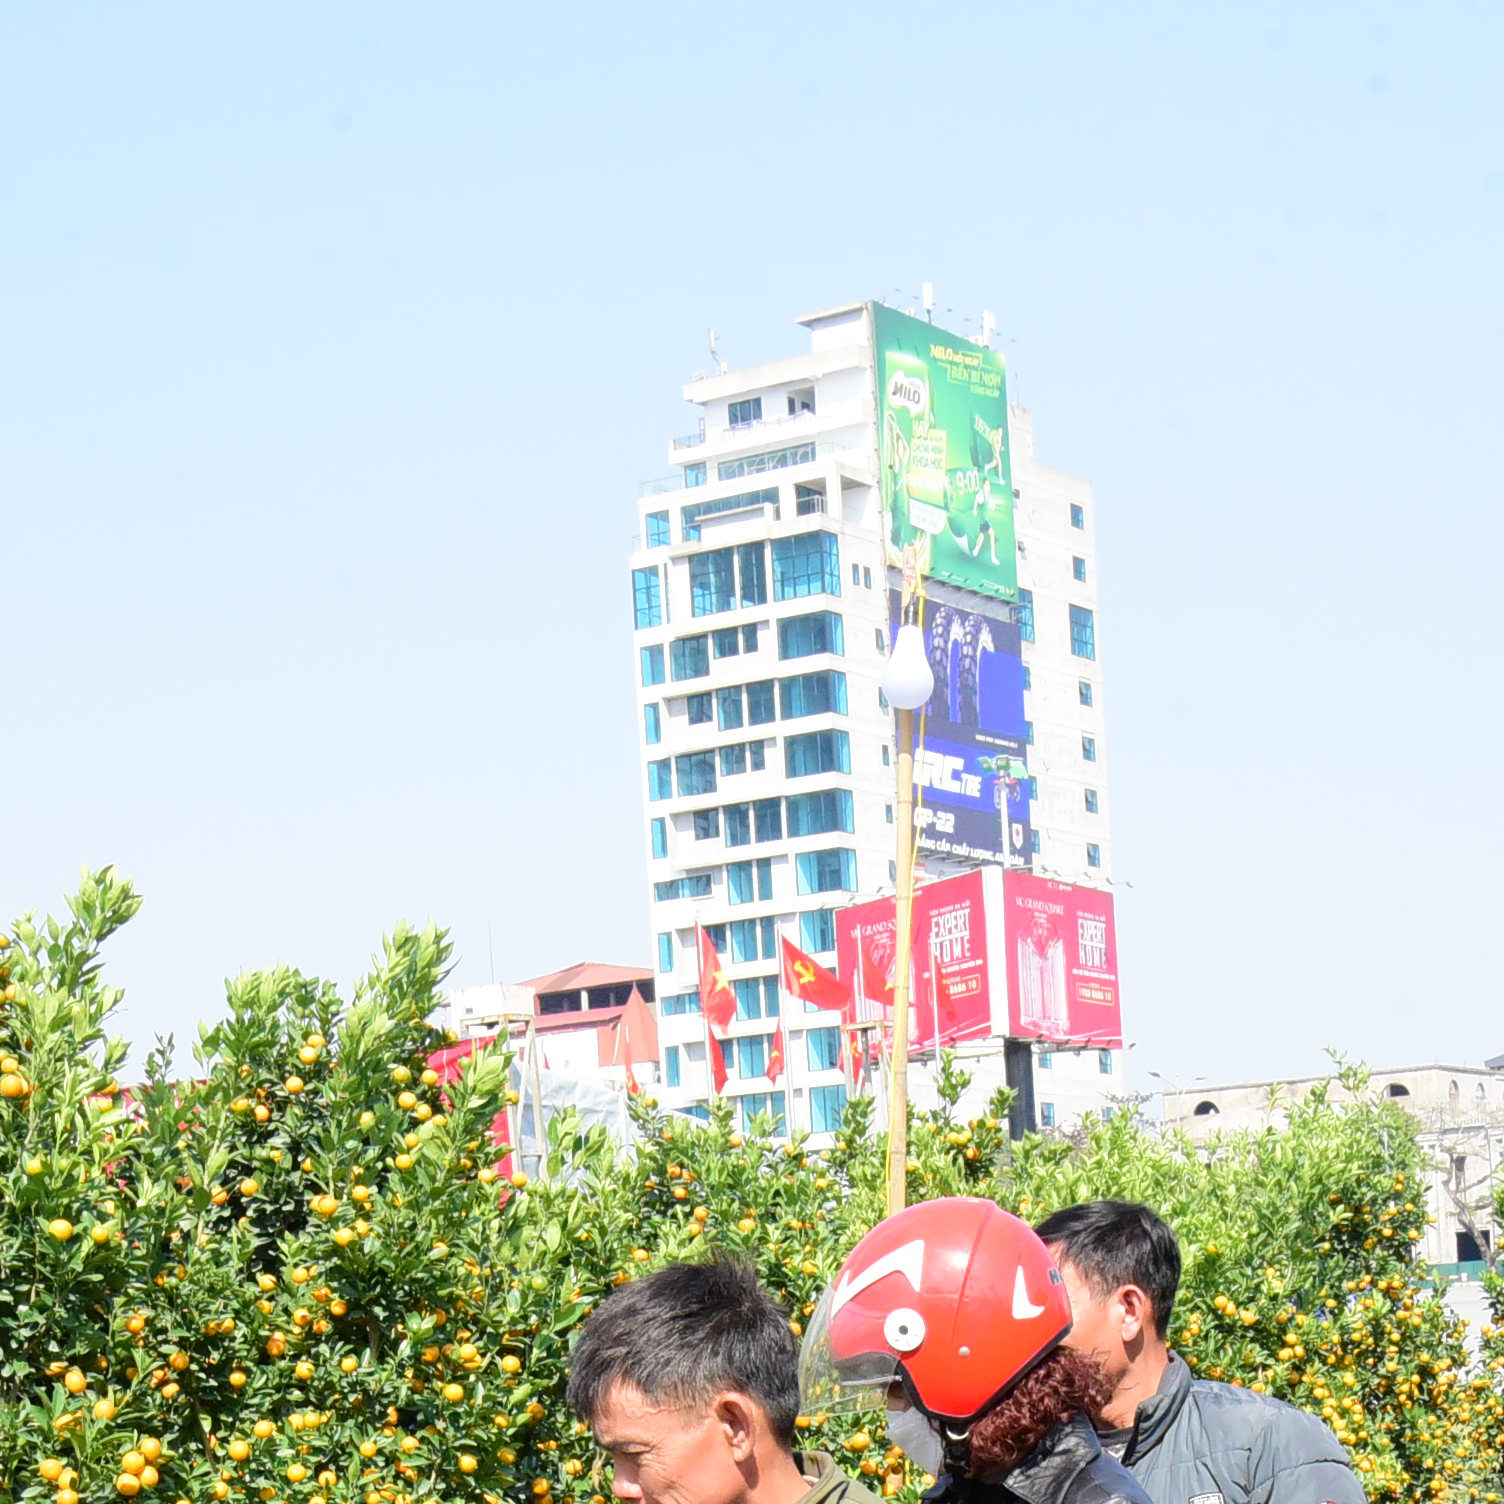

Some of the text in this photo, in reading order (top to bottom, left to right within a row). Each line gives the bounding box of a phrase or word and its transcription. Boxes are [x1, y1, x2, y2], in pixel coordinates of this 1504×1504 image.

[930, 344, 953, 361] MILO
[892, 381, 921, 405] MILO
[956, 470, 980, 495] 9:00
[960, 773, 982, 798] TIRE
[914, 807, 955, 834] GP-22
[952, 842, 970, 856] CHẤT
[1009, 853, 1025, 866] OÀN
[931, 908, 970, 939] EXPERT
[1078, 918, 1106, 944] EXPERT
[932, 936, 971, 964] HOME
[1079, 942, 1106, 968] HOME
[968, 980, 977, 990] 10
